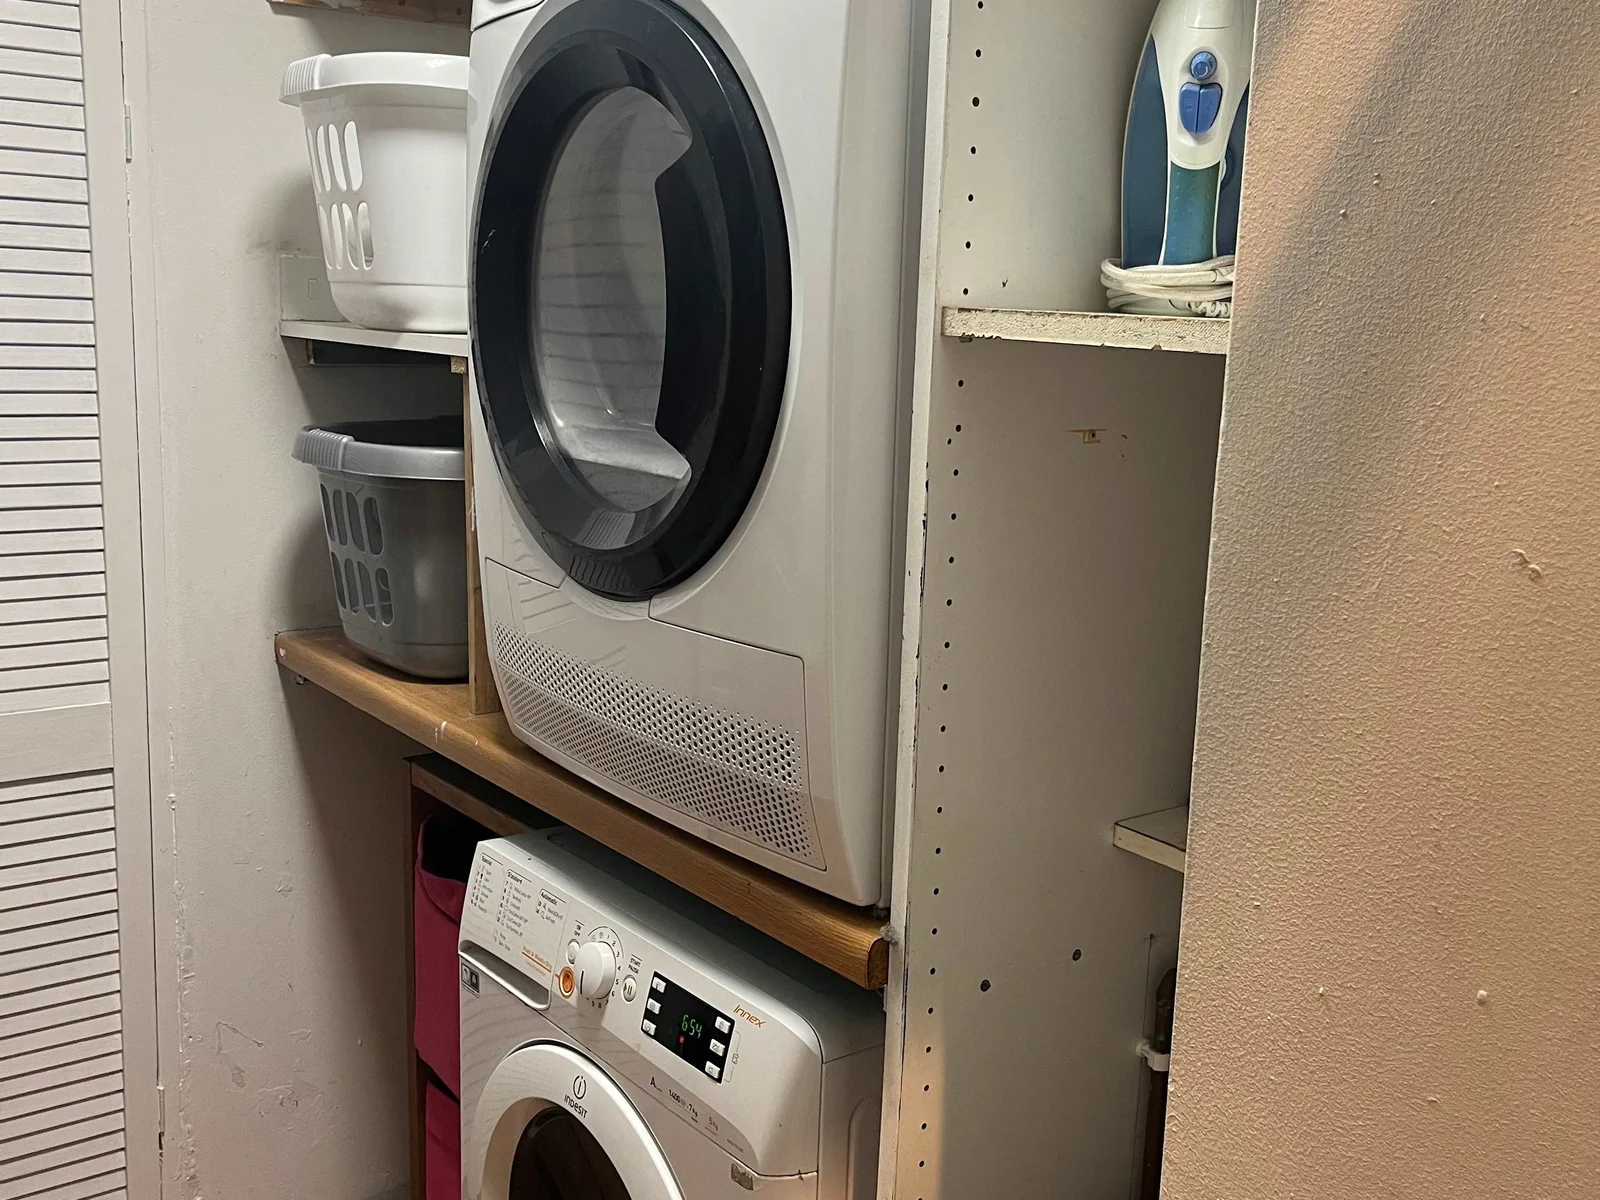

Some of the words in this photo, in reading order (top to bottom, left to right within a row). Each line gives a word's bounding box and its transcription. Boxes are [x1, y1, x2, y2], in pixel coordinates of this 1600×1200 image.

[507, 871, 523, 885] Standard
[629, 957, 641, 968] START
[733, 1004, 766, 1028] Innex
